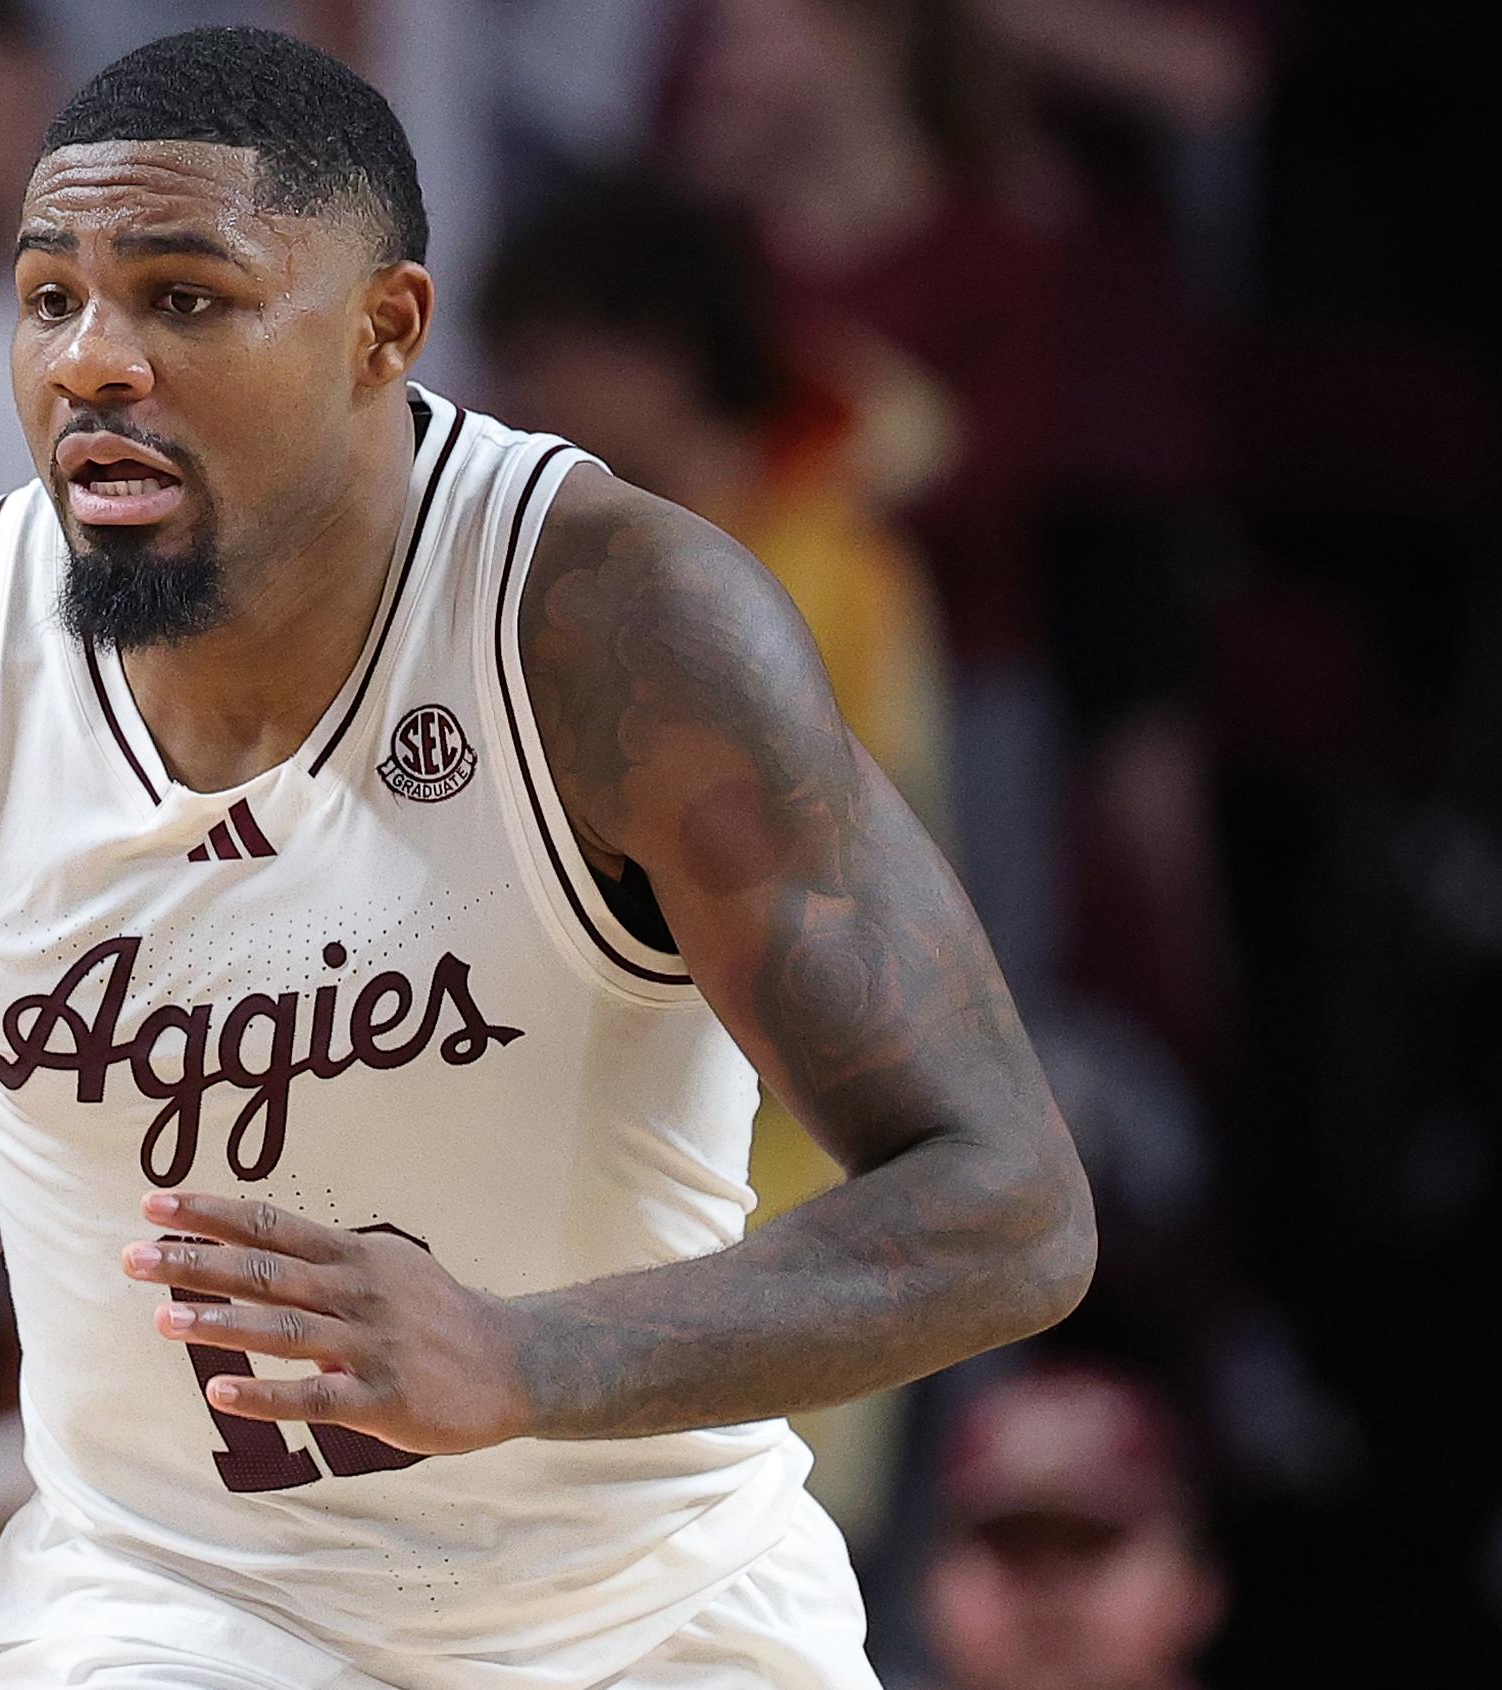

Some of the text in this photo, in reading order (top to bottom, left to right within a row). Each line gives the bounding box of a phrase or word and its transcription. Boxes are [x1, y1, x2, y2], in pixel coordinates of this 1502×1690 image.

[399, 712, 458, 775] SEC
[392, 766, 468, 798] GRADUATE
[156, 1223, 432, 1493] 1
